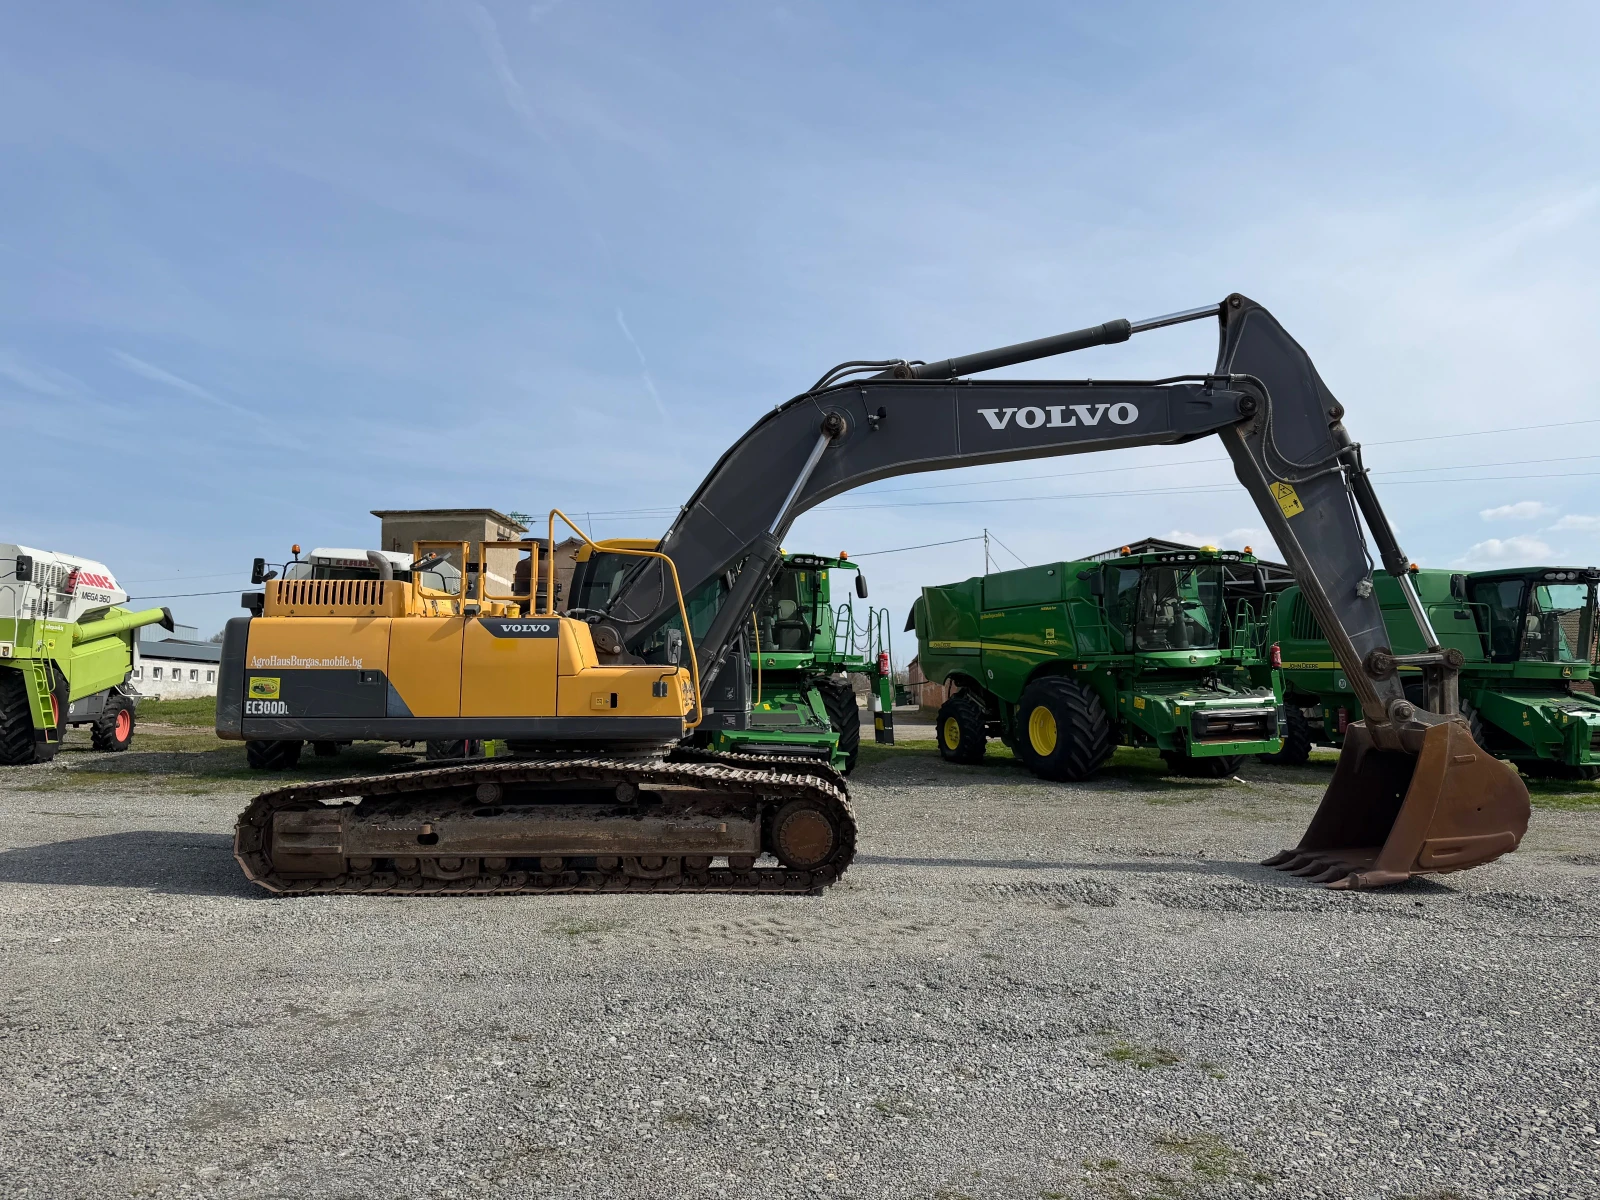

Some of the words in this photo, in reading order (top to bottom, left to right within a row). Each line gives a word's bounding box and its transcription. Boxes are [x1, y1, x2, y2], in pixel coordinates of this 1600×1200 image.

[977, 402, 1139, 430] VOLVO
[77, 571, 115, 590] LAAS
[81, 591, 98, 602] MEGA
[99, 595, 111, 604] 360
[500, 624, 550, 632] VOLVO
[251, 655, 362, 668] AgroHausBurgas.mobile.bg
